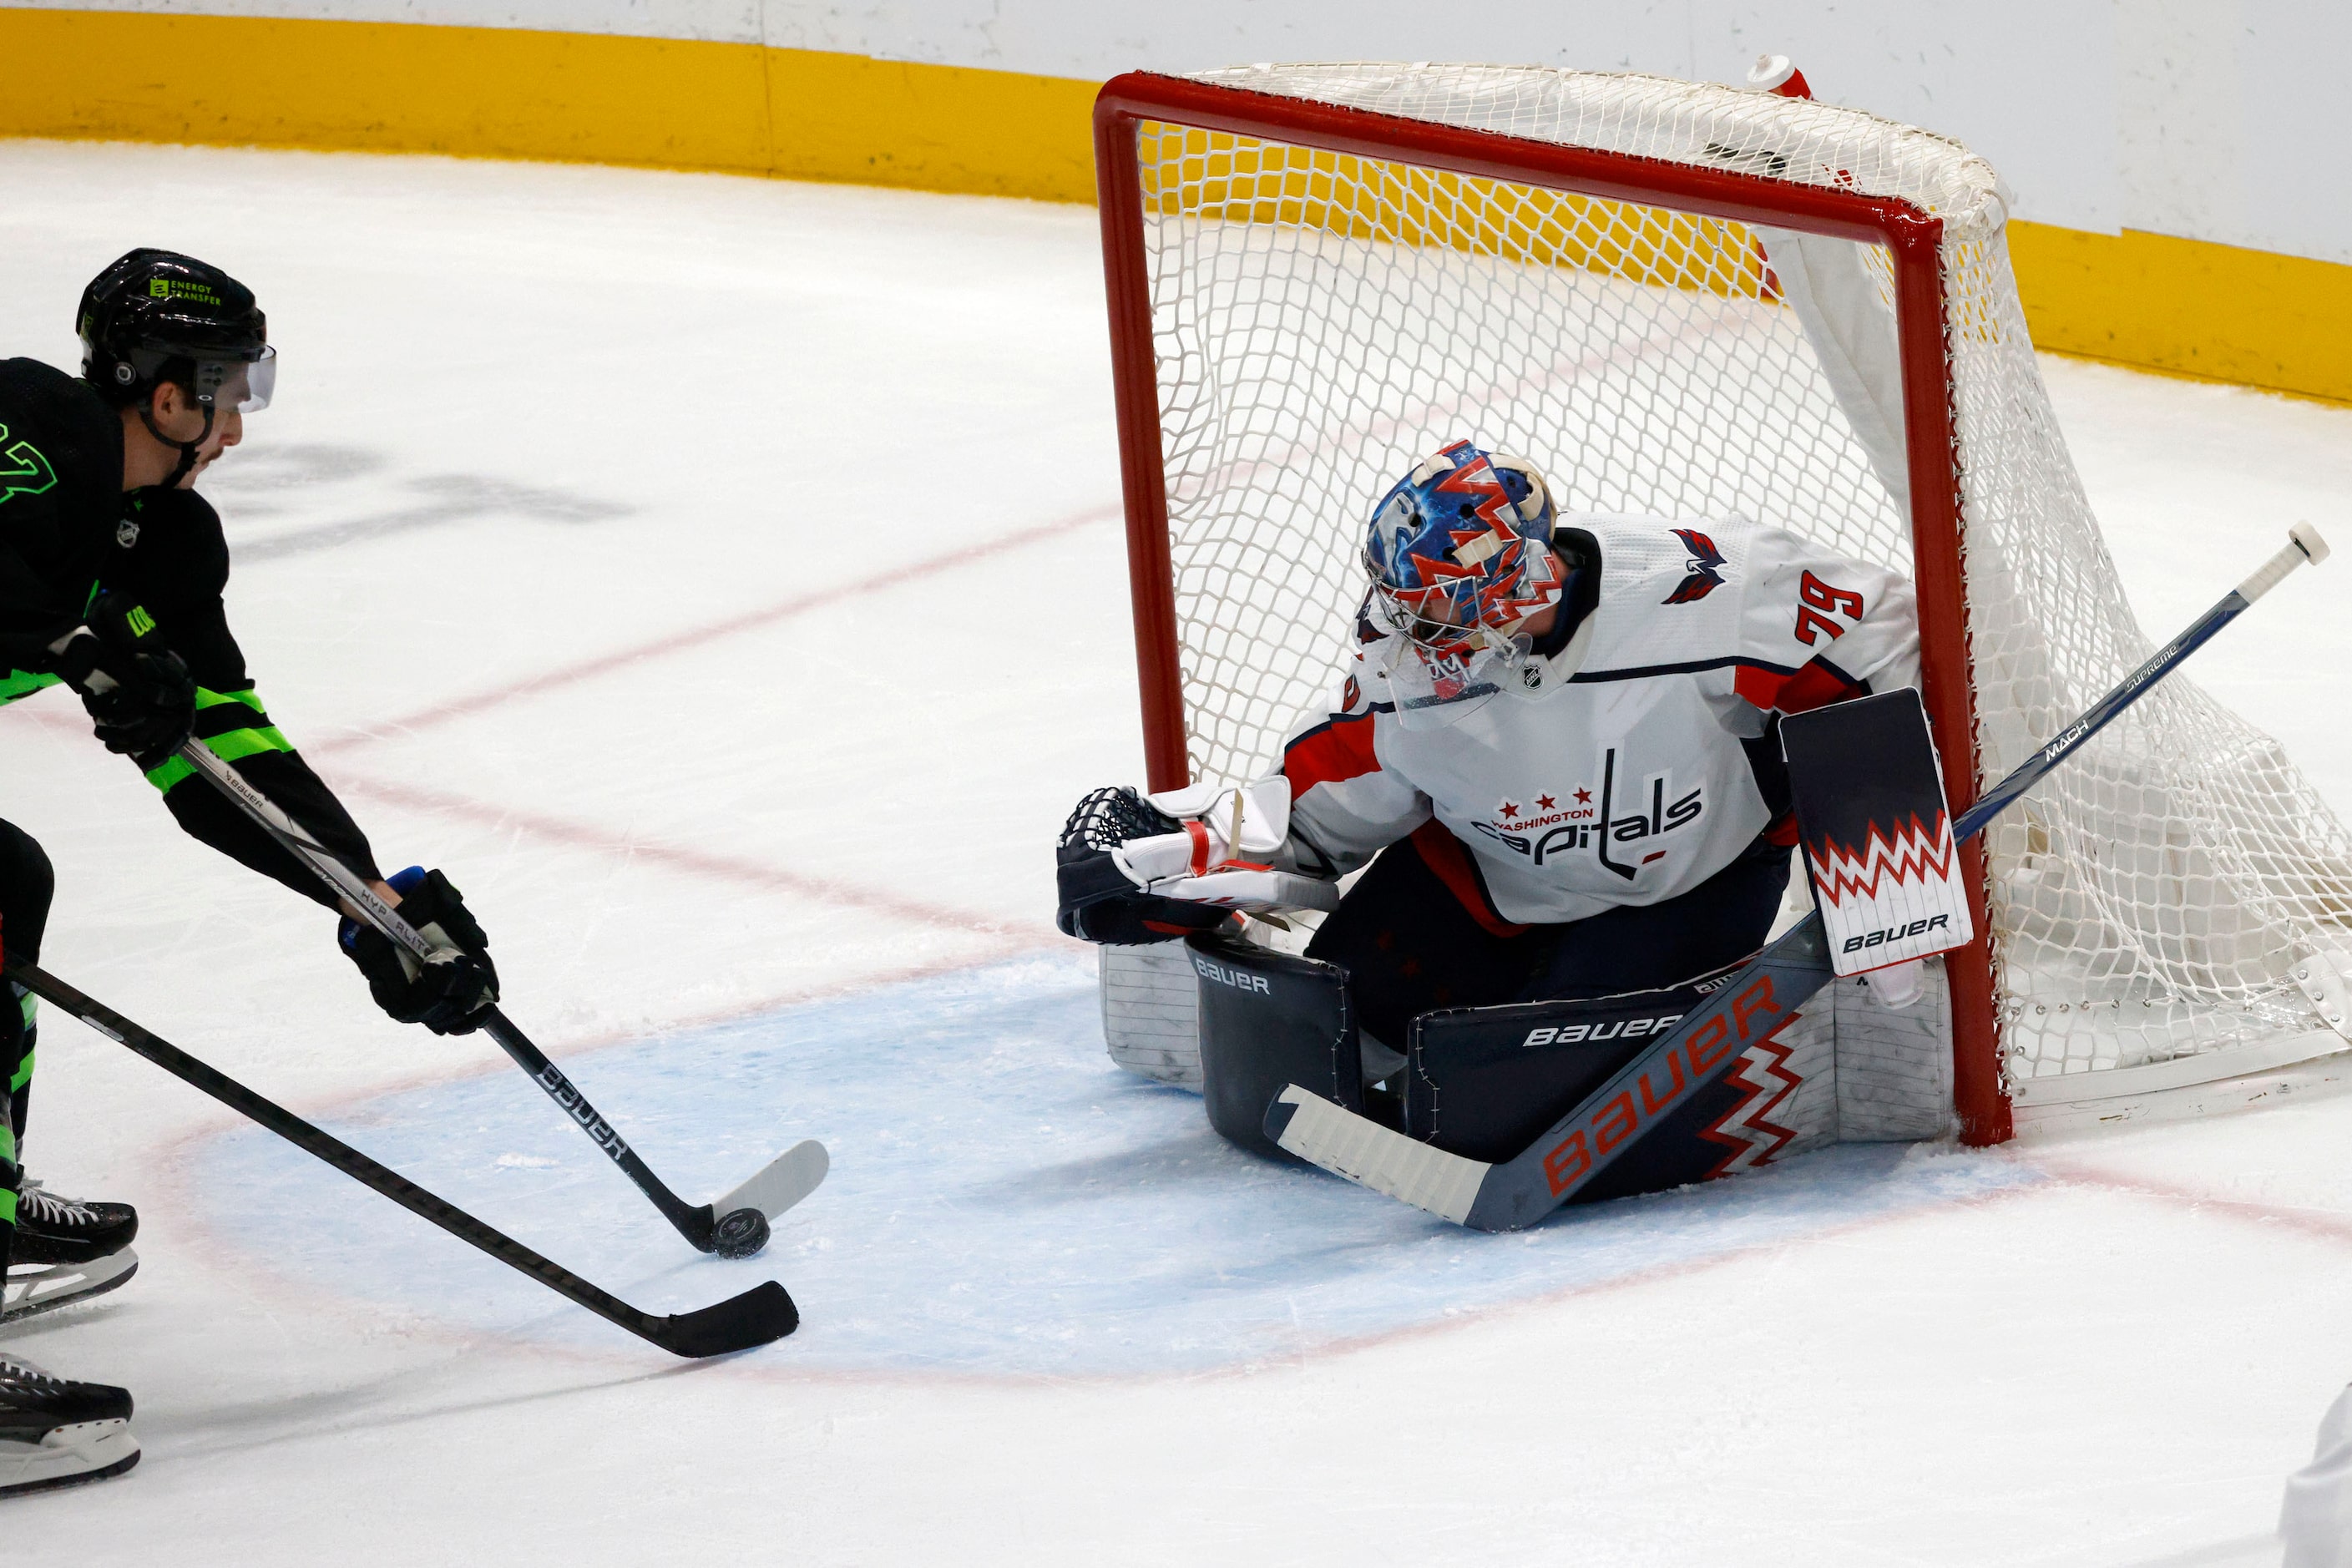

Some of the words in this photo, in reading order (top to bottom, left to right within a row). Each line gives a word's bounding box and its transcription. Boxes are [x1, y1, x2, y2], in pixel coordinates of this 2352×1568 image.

[170, 280, 212, 294] ENERGY
[170, 290, 222, 306] TRANSFER
[1794, 569, 1864, 647] 79
[2126, 644, 2178, 693] SUPREME
[2046, 719, 2090, 762] MACH
[230, 778, 264, 809] BAUER
[1490, 807, 1594, 832] WASHINGTON
[1842, 913, 1950, 954] BAUER
[1195, 957, 1271, 995] BAUER
[1543, 974, 1783, 1199] BAUER
[536, 1062, 629, 1161] BAUER
